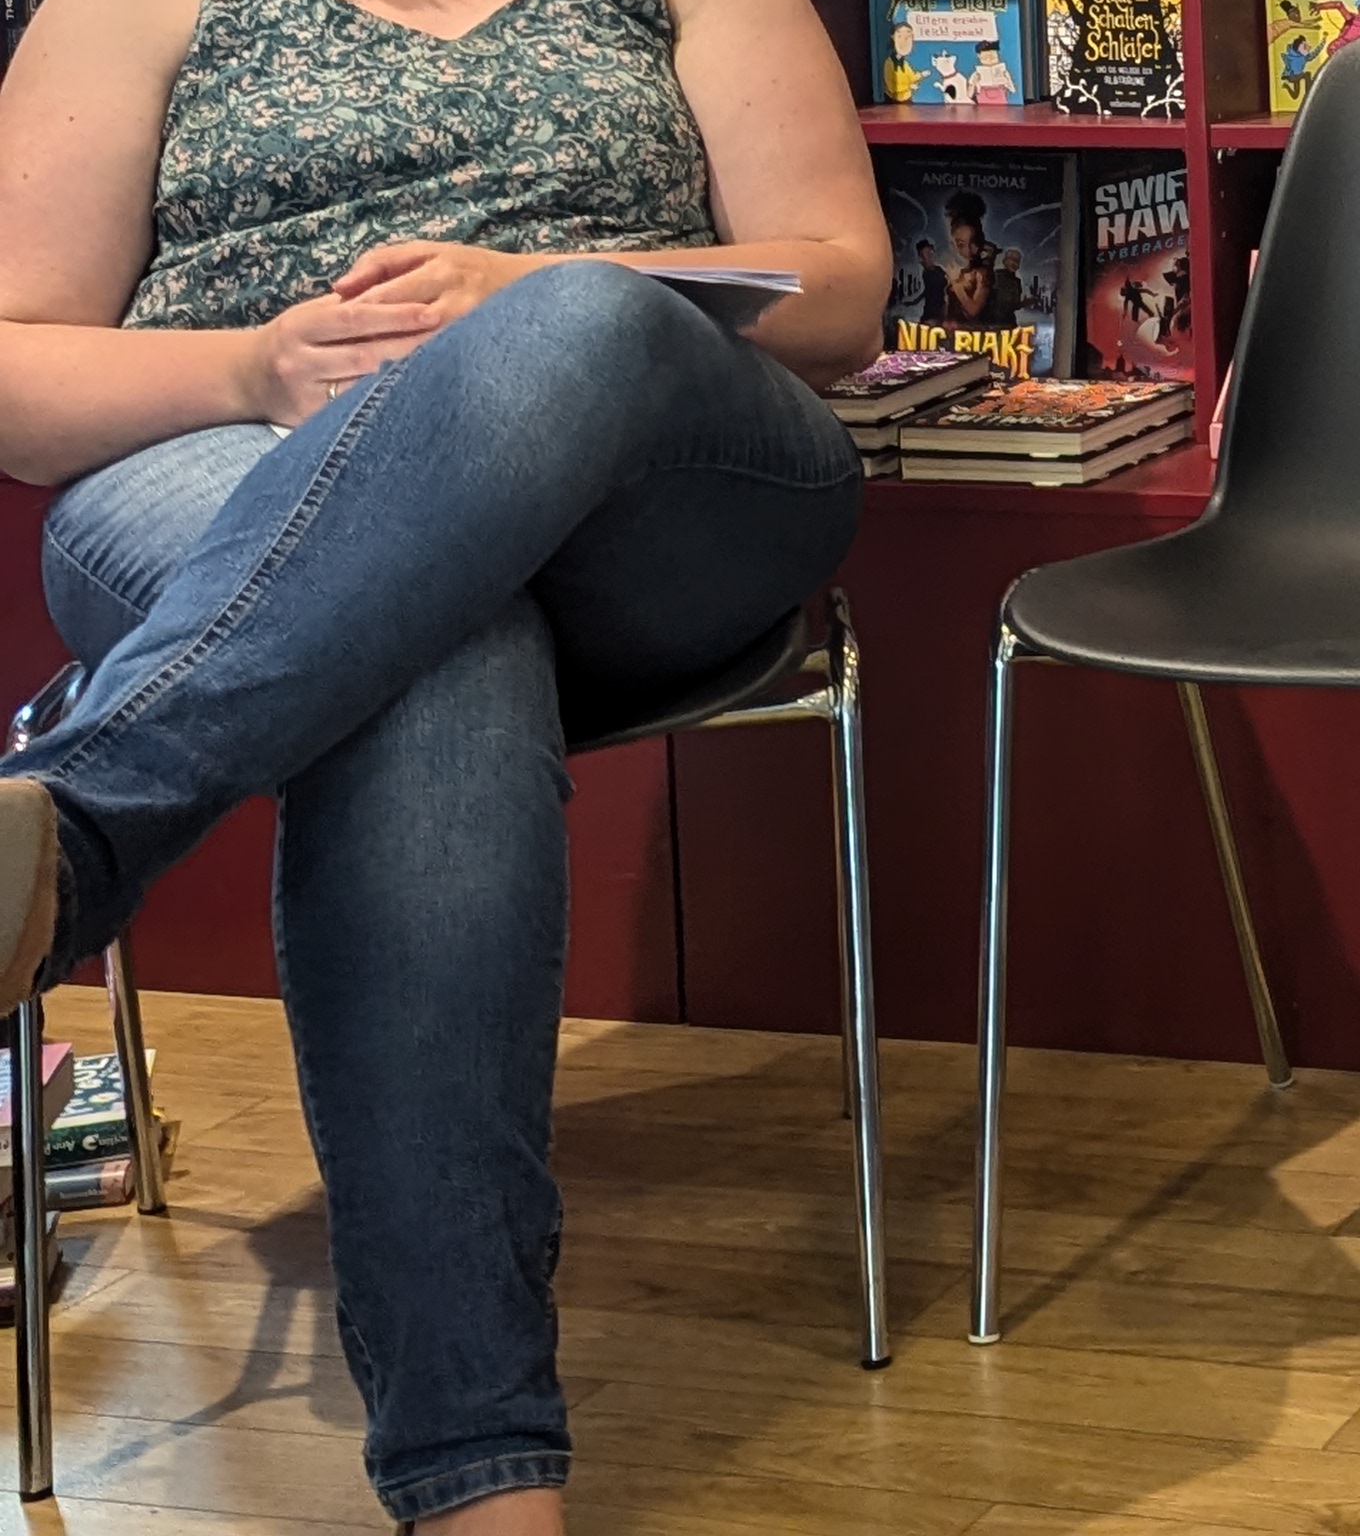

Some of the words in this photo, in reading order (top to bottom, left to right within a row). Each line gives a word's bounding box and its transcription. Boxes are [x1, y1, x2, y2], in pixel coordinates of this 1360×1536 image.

[1086, 4, 1160, 31] Schatten-
[1085, 31, 1162, 64] Schläfer
[922, 172, 965, 188] ANGIE
[968, 173, 1027, 190] THOMAS
[1095, 168, 1188, 216] SWIF
[1097, 202, 1190, 250] HAW
[898, 321, 946, 353] NIC
[954, 322, 1035, 379] BLAKE
